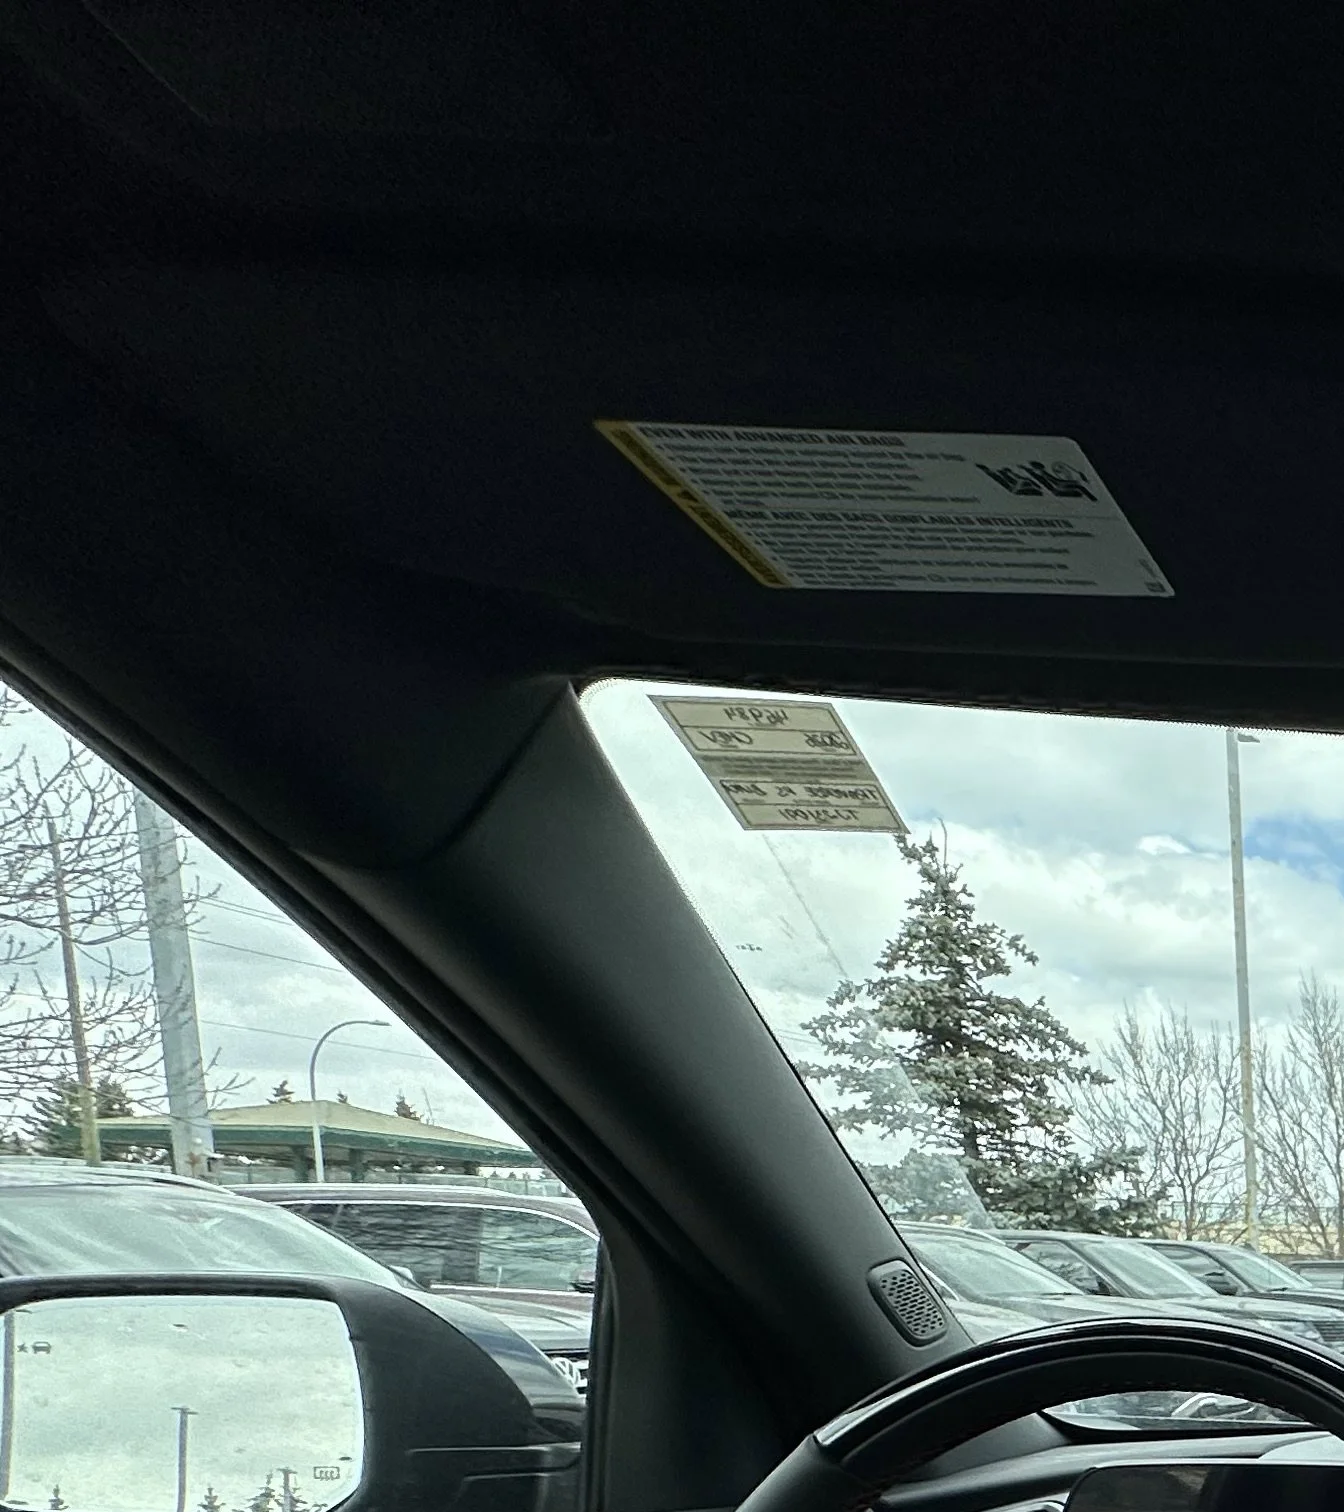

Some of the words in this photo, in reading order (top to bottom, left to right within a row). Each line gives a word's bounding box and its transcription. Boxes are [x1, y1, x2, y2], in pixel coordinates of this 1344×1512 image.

[683, 428, 735, 441] WITH
[728, 430, 825, 444] ADVANCED
[823, 433, 858, 445] AIR
